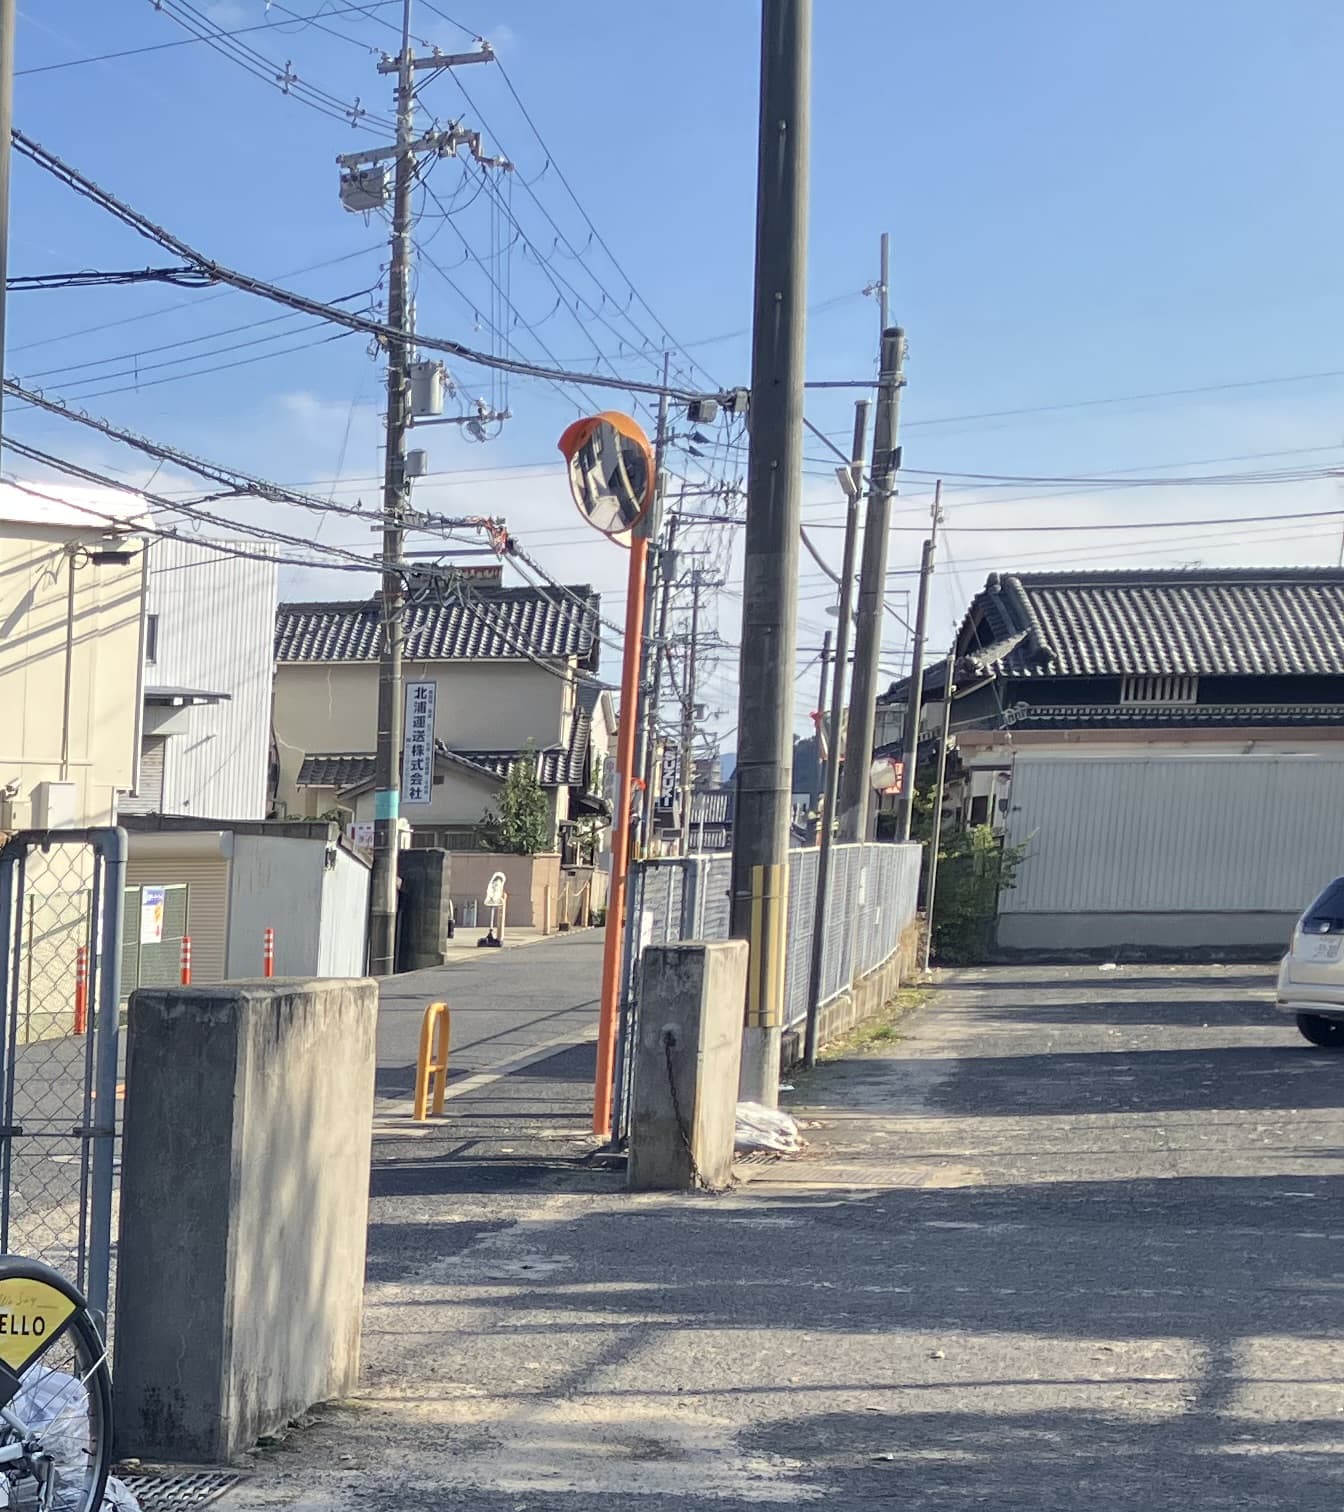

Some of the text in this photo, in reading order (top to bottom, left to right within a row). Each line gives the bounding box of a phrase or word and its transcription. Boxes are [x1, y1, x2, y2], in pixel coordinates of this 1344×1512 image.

[409, 686, 428, 800] 北浦運送株式会社
